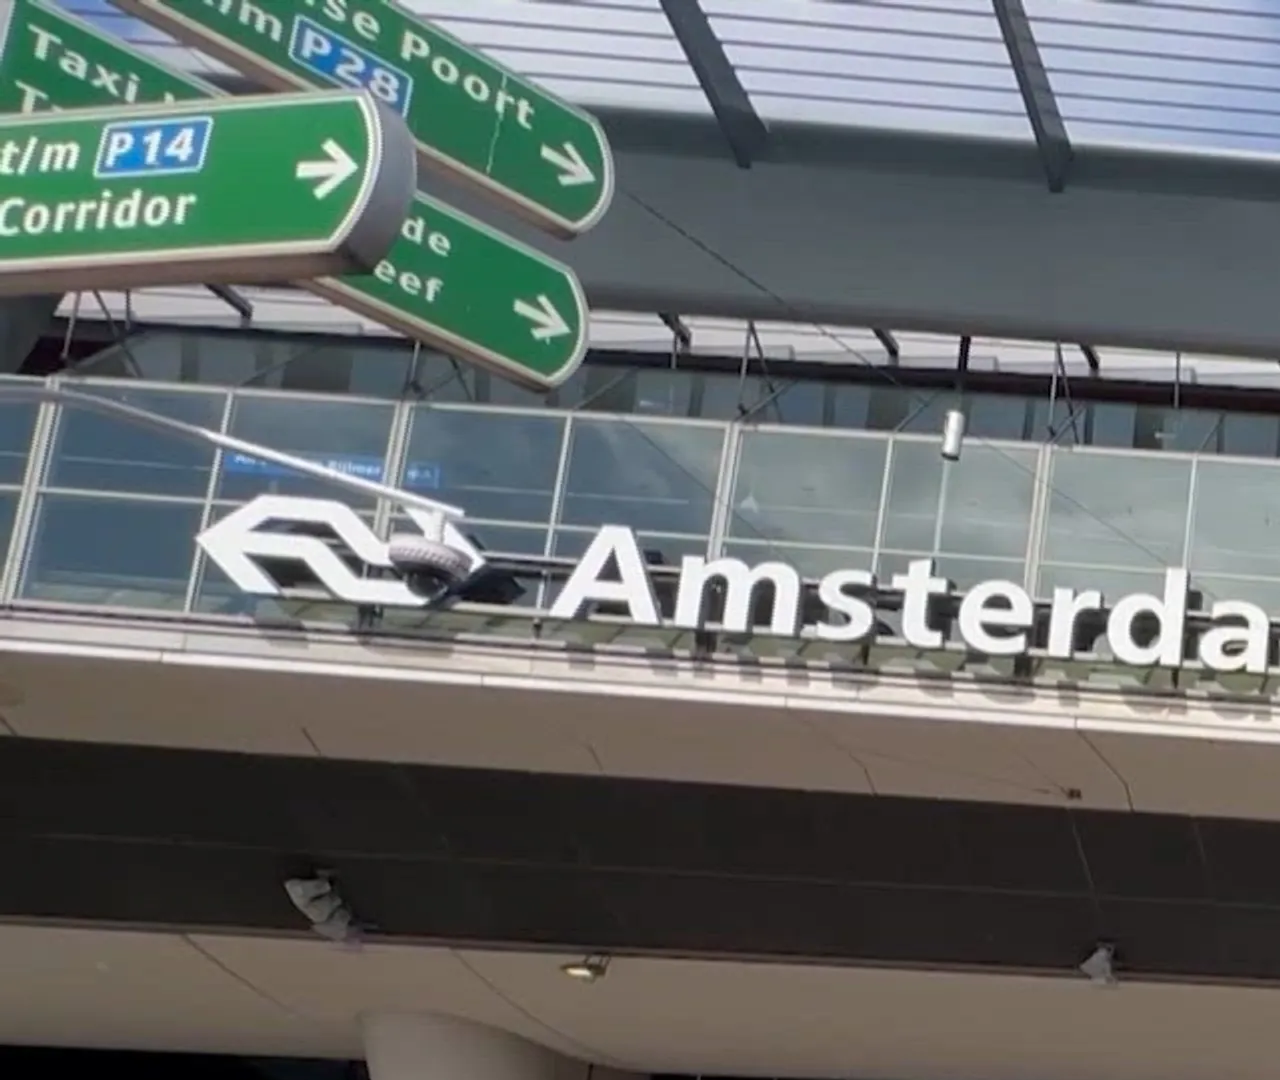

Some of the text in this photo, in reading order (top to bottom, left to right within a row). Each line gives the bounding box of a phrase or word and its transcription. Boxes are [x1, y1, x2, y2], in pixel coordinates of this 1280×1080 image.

[27, 22, 141, 104] Taxi
[400, 29, 535, 131] Poort
[0, 127, 194, 176] t/m P14
[0, 187, 198, 236] Corridor
